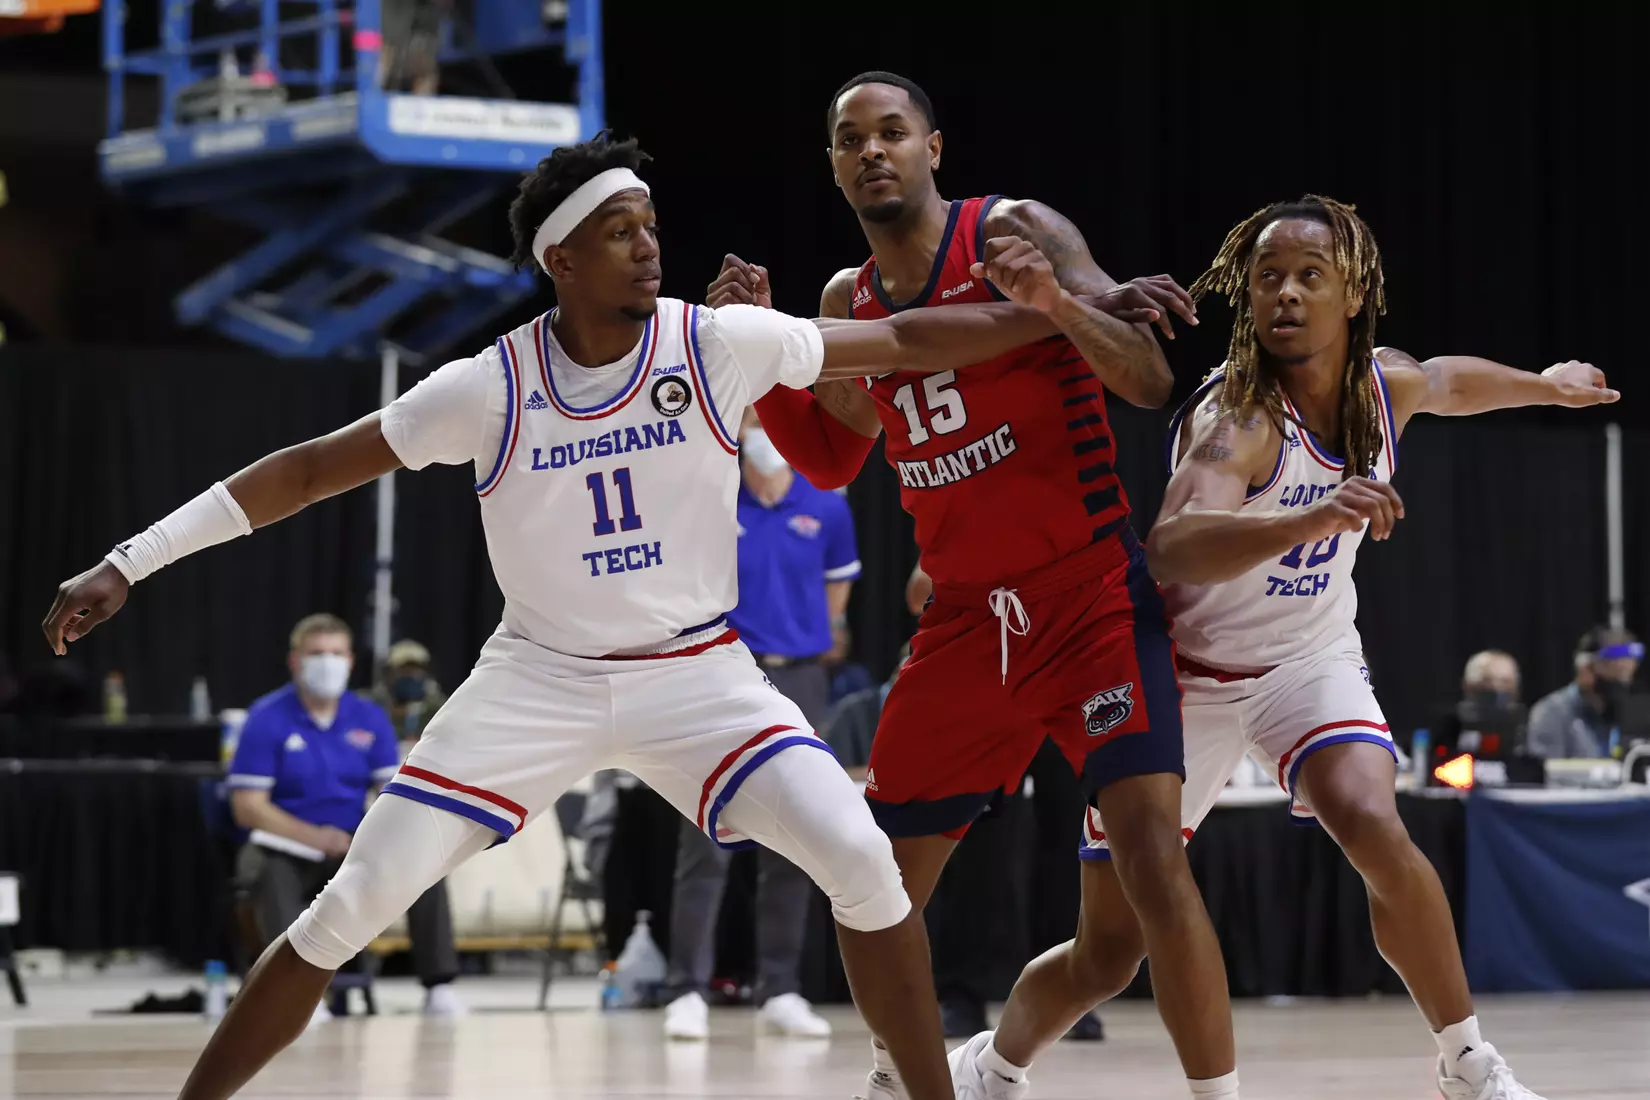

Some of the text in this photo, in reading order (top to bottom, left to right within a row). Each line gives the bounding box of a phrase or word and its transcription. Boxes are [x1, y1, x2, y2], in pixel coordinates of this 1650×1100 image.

[852, 294, 872, 309] adidas
[524, 401, 549, 410] adidas
[892, 369, 967, 446] 15
[531, 419, 686, 471] LOUISIANA
[896, 421, 1018, 489] ATLANTIC
[586, 467, 643, 537] 11
[582, 541, 663, 577] TECH
[1265, 573, 1330, 597] TECH
[1082, 685, 1128, 715] FAU
